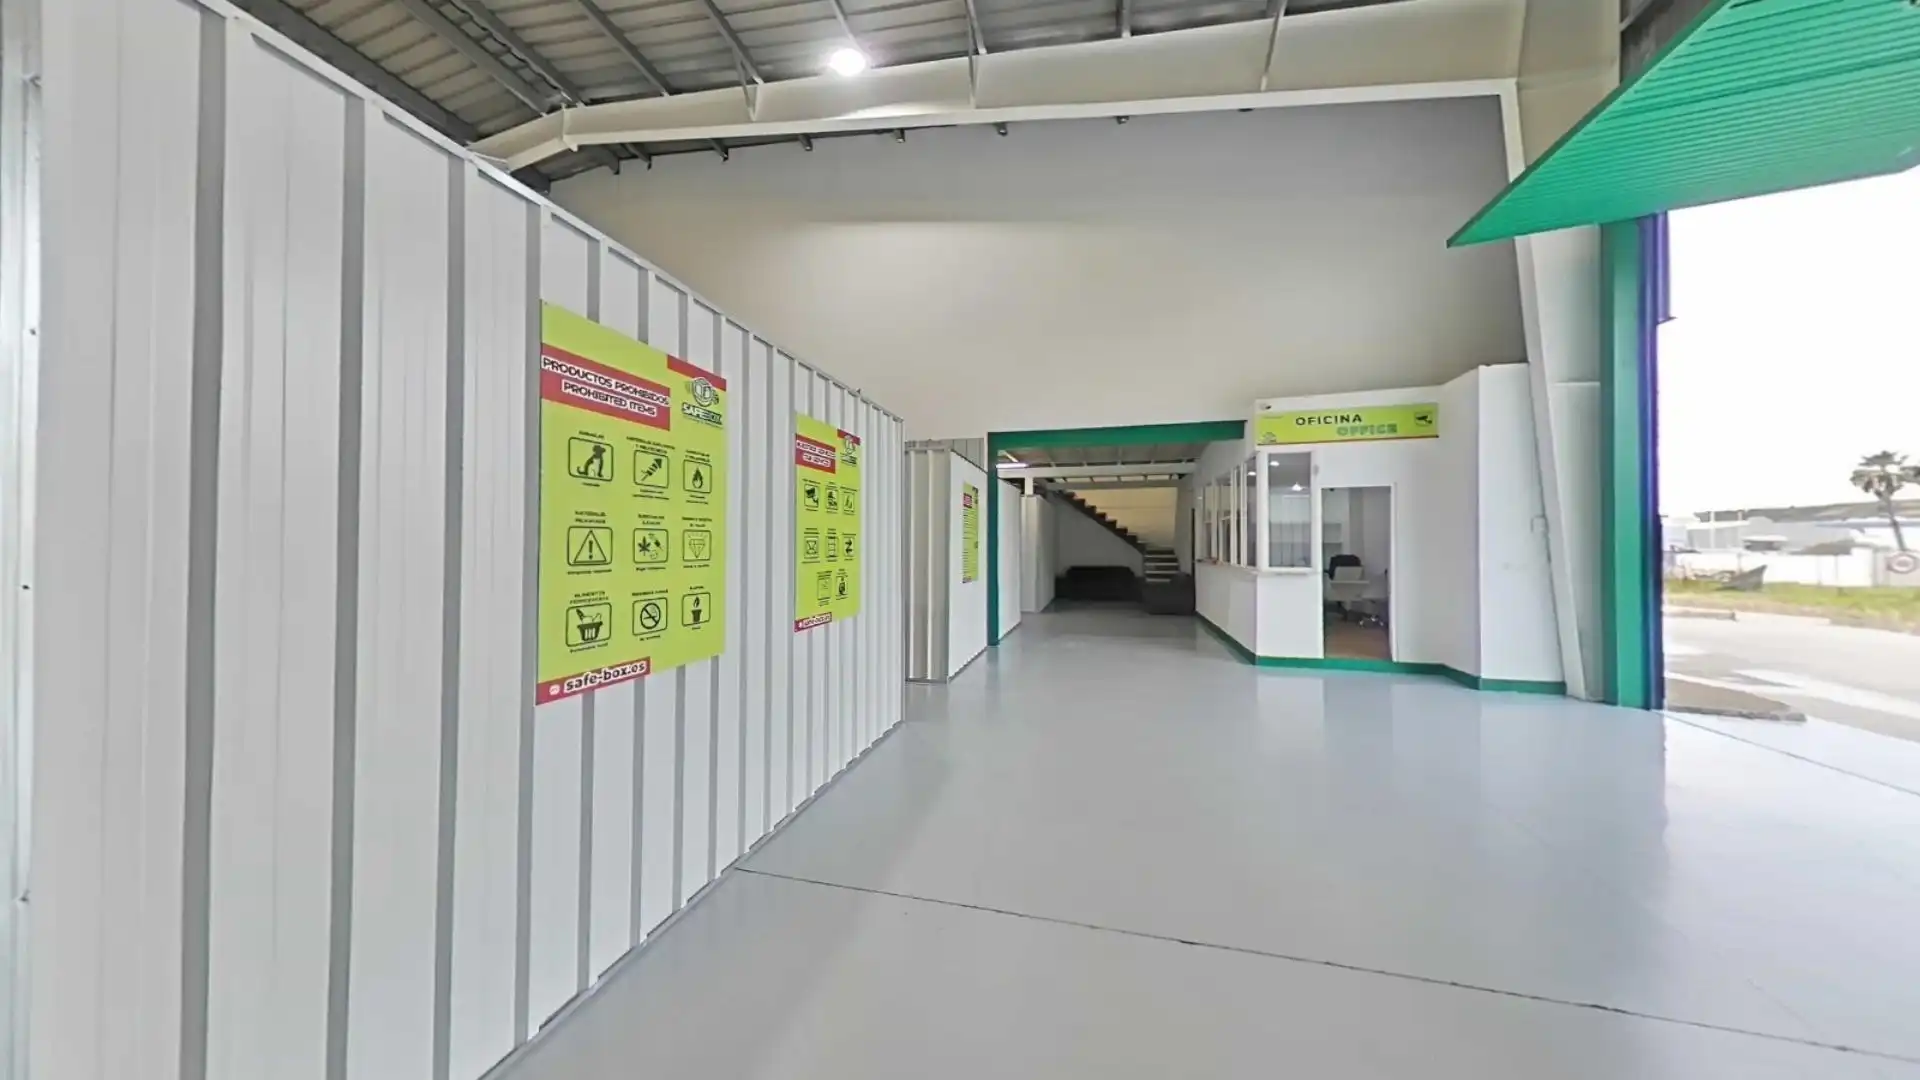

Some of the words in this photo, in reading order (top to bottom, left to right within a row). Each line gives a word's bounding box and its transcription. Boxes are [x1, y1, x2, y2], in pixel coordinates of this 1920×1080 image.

[542, 357, 613, 389] PRODUCTOS
[615, 382, 669, 405] PROHIBIDOS
[564, 381, 627, 407] PROHIBITED
[629, 402, 656, 416] ITEMS
[1295, 414, 1363, 426] OFICINA
[1337, 423, 1398, 436] OFFICE
[565, 661, 645, 691] safe-box.es
